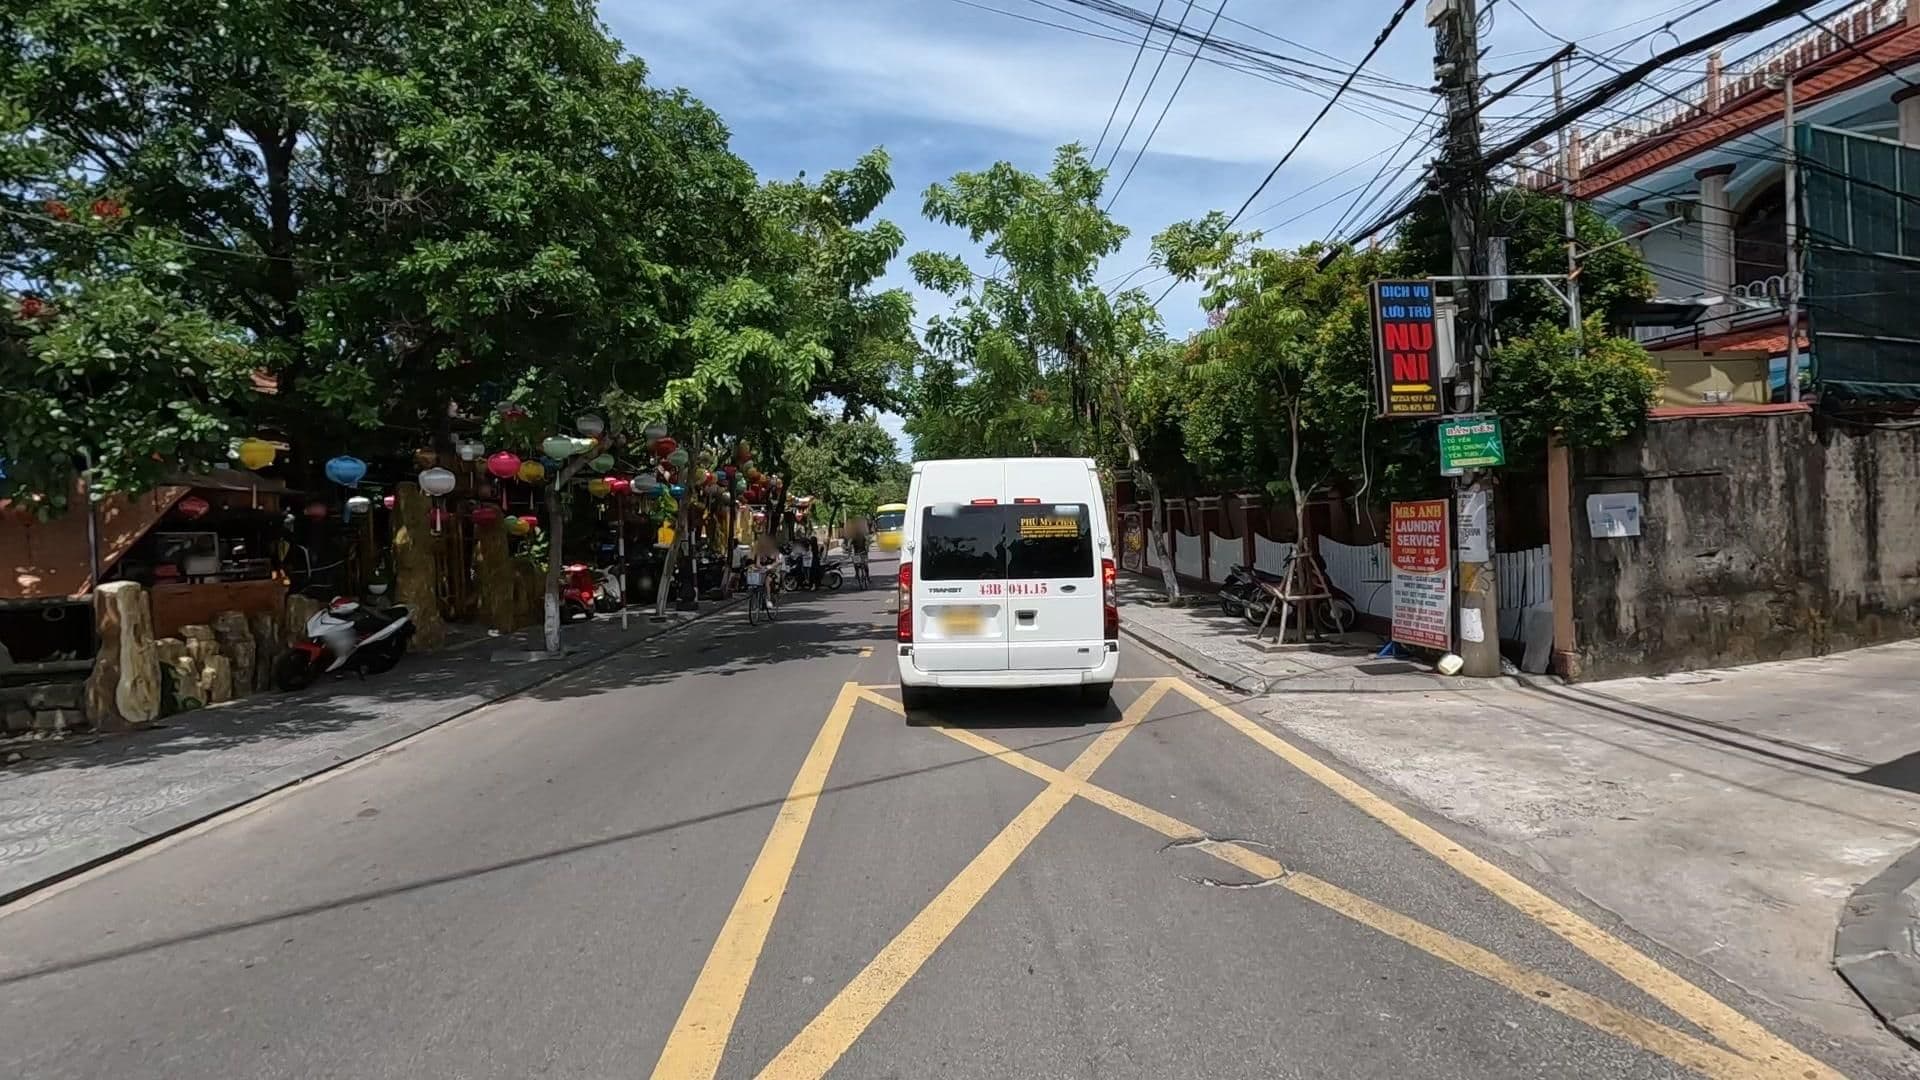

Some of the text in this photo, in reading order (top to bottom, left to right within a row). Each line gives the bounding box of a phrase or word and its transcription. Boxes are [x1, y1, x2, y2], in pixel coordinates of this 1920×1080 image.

[1382, 286, 1430, 300] DỊCH VỤ
[1385, 323, 1433, 350] NU
[1393, 353, 1430, 381] NI
[1395, 505, 1441, 518] MRS ANH
[1395, 519, 1441, 533] LAUNDRY
[1397, 534, 1440, 547] SERVICE
